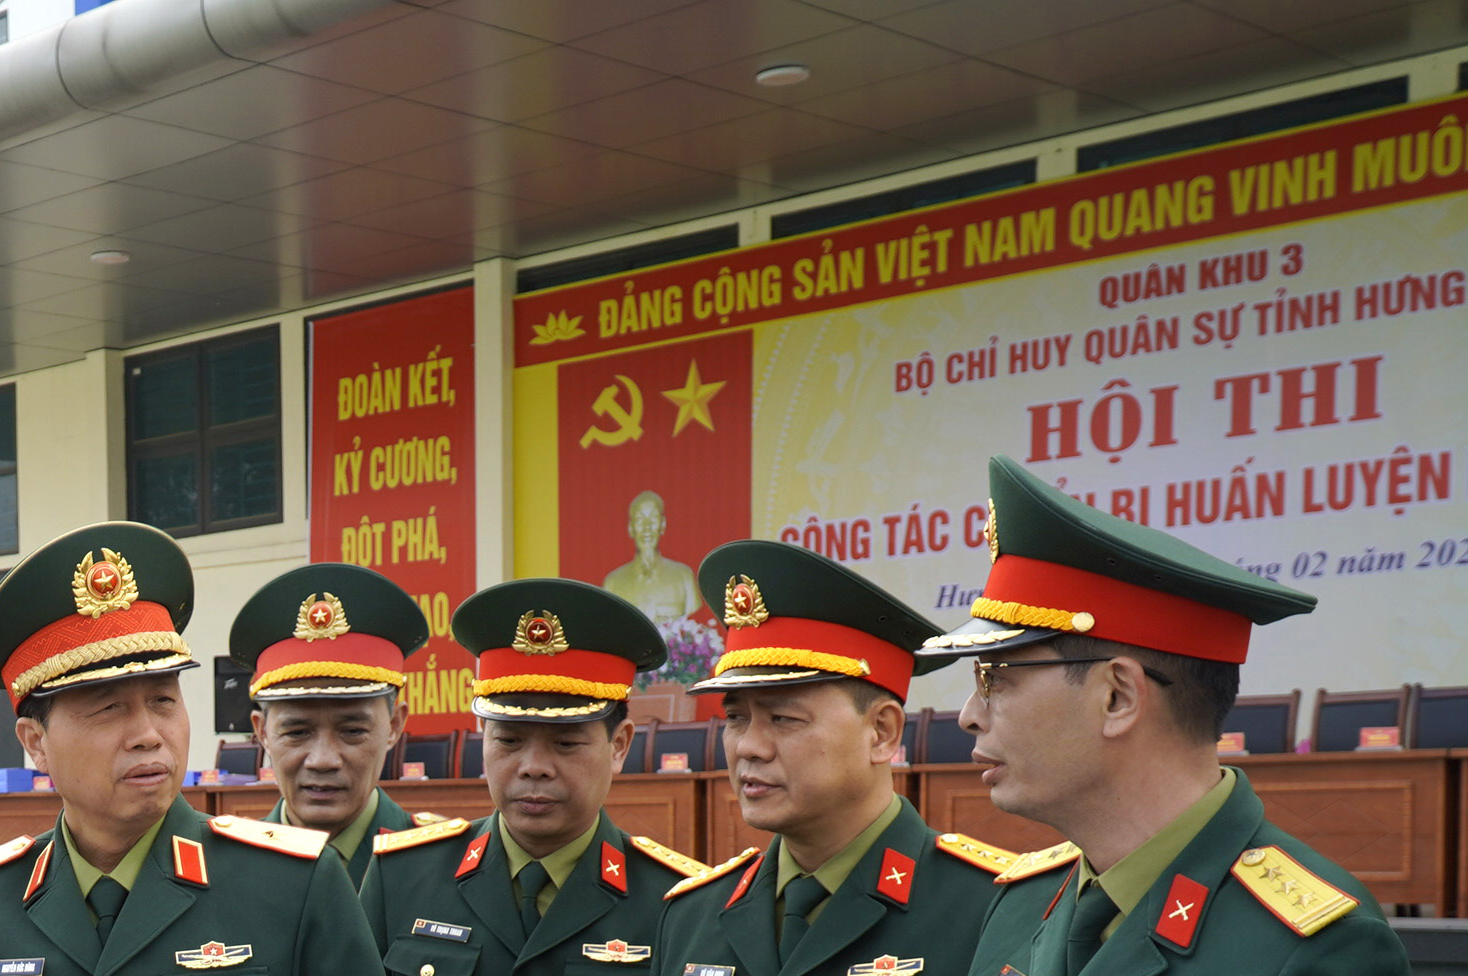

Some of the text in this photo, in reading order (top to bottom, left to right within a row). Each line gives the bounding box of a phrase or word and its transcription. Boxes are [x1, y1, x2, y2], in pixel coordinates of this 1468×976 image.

[599, 114, 1468, 338] ĐẢNG CỘNG SẢN VIỆT NAM QUANG VINH MUÔ
[1099, 243, 1304, 309] QUÂN KHU 3
[895, 269, 1466, 396] BỘ CHỈ HUY QUÂN SỰ TỈNH HƯNG
[337, 344, 456, 421] ĐOÀN KẾT,
[1026, 355, 1386, 464] HỘI THI
[333, 435, 458, 497] KỶ CƯƠNG,
[883, 503, 949, 556] TÁC
[1166, 456, 1286, 528] HUẤN
[1303, 445, 1451, 516] LUYỆN
[391, 506, 447, 565] PHÁ,
[1292, 551, 1328, 579] 02
[1336, 546, 1405, 576] năm
[1416, 538, 1468, 569] 202
